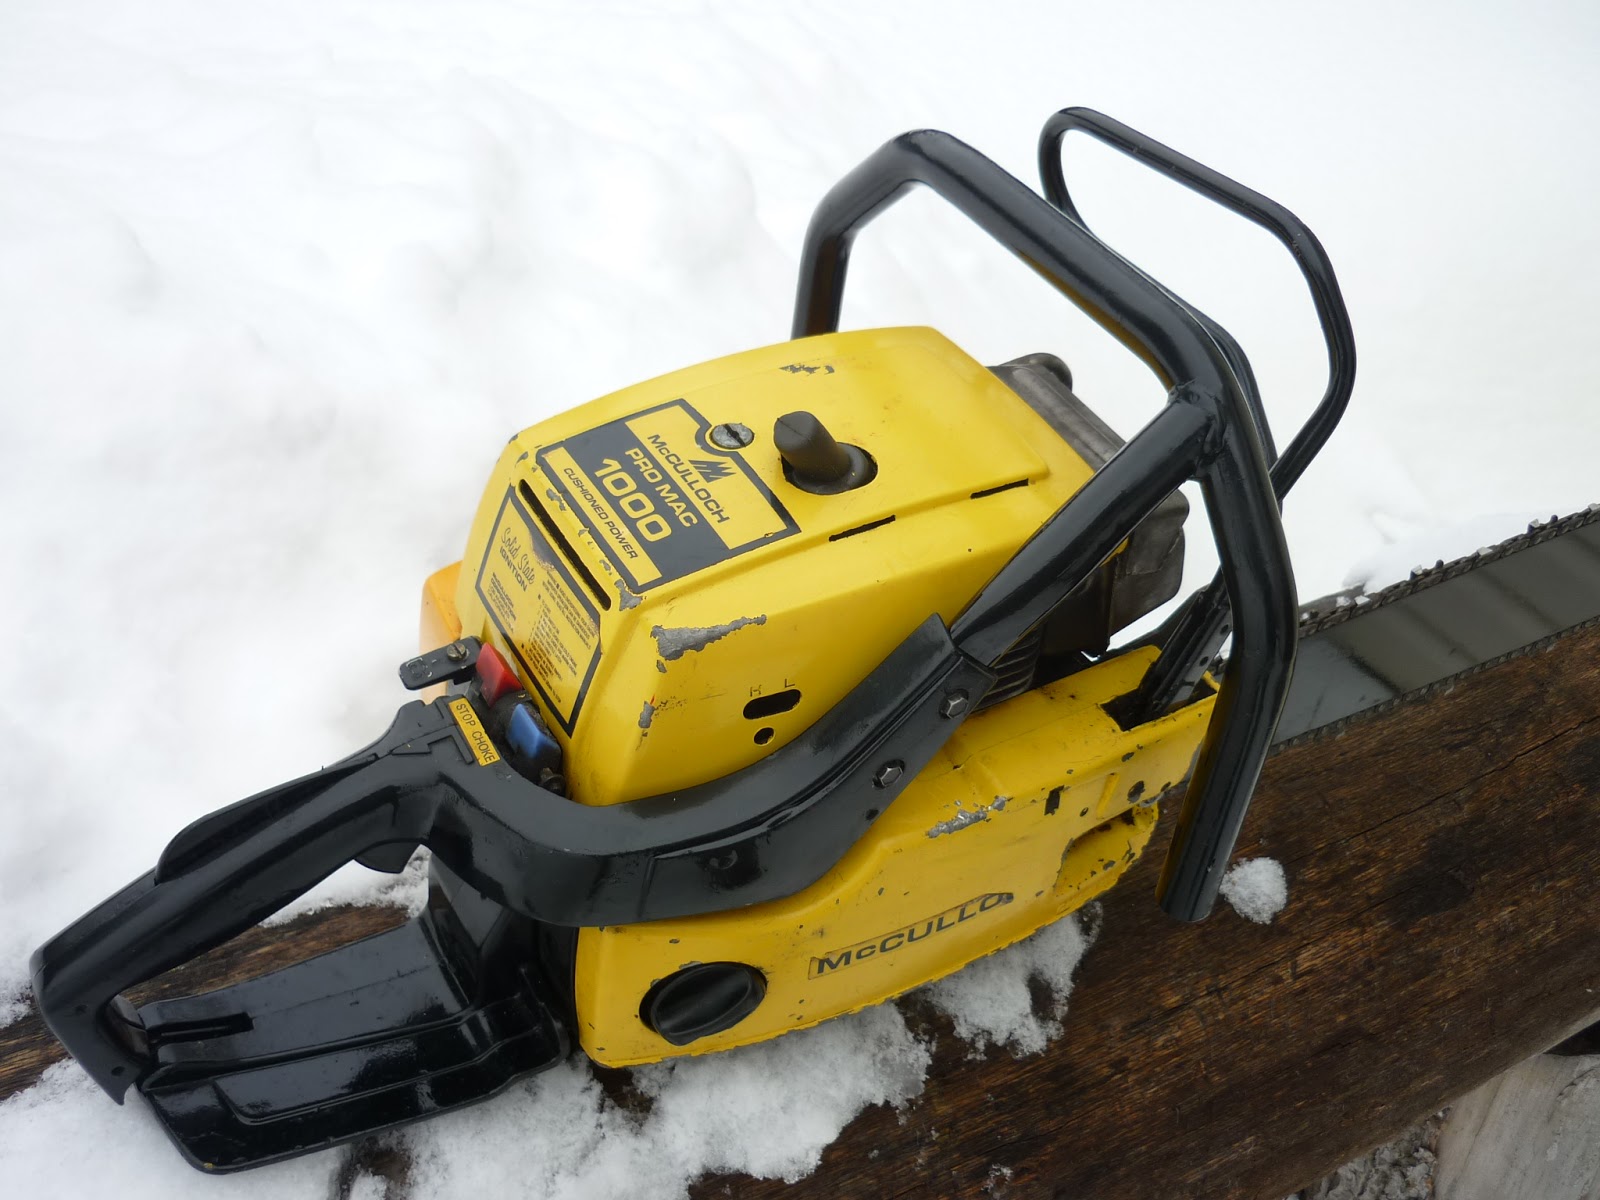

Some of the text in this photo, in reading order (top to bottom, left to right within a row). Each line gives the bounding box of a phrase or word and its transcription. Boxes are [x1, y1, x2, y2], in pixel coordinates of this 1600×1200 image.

[563, 467, 608, 521] CUSHIONED
[604, 519, 639, 561] POWER
[594, 458, 672, 542] 1000
[625, 448, 698, 528] PRO MAC
[647, 434, 730, 524] McCULLOCH
[500, 546, 528, 593] IGNITION
[502, 527, 536, 586] Solid State
[750, 678, 796, 697] H L
[456, 703, 496, 763] STOP CHOKE
